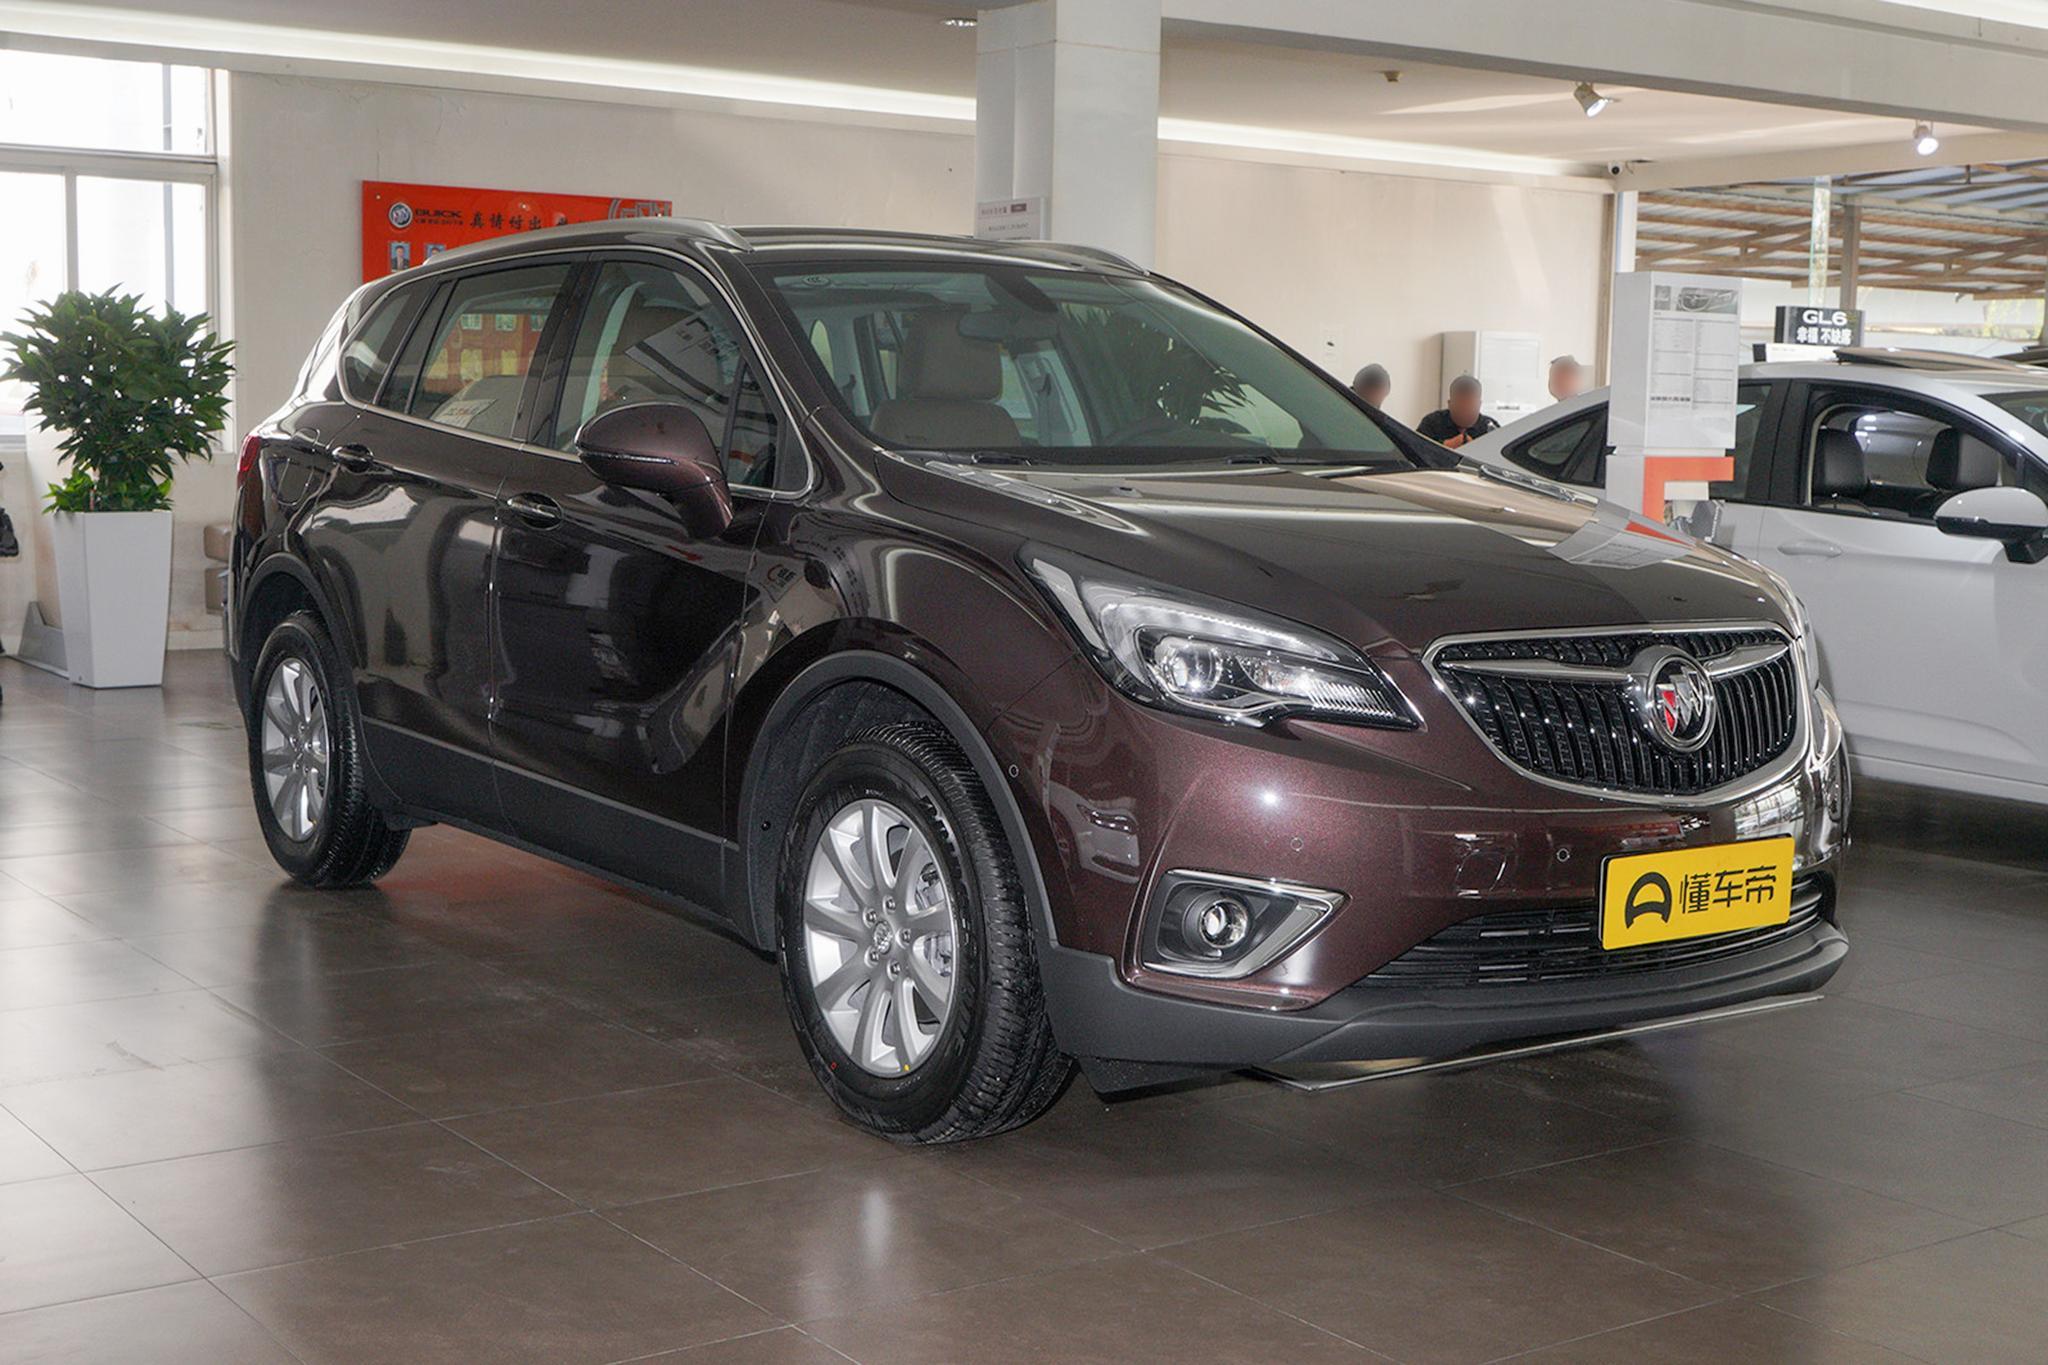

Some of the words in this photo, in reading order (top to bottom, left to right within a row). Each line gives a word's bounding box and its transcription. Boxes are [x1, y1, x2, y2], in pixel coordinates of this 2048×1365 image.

[1803, 310, 1847, 326] GL6
[1679, 865, 1777, 914] 懂车帝
